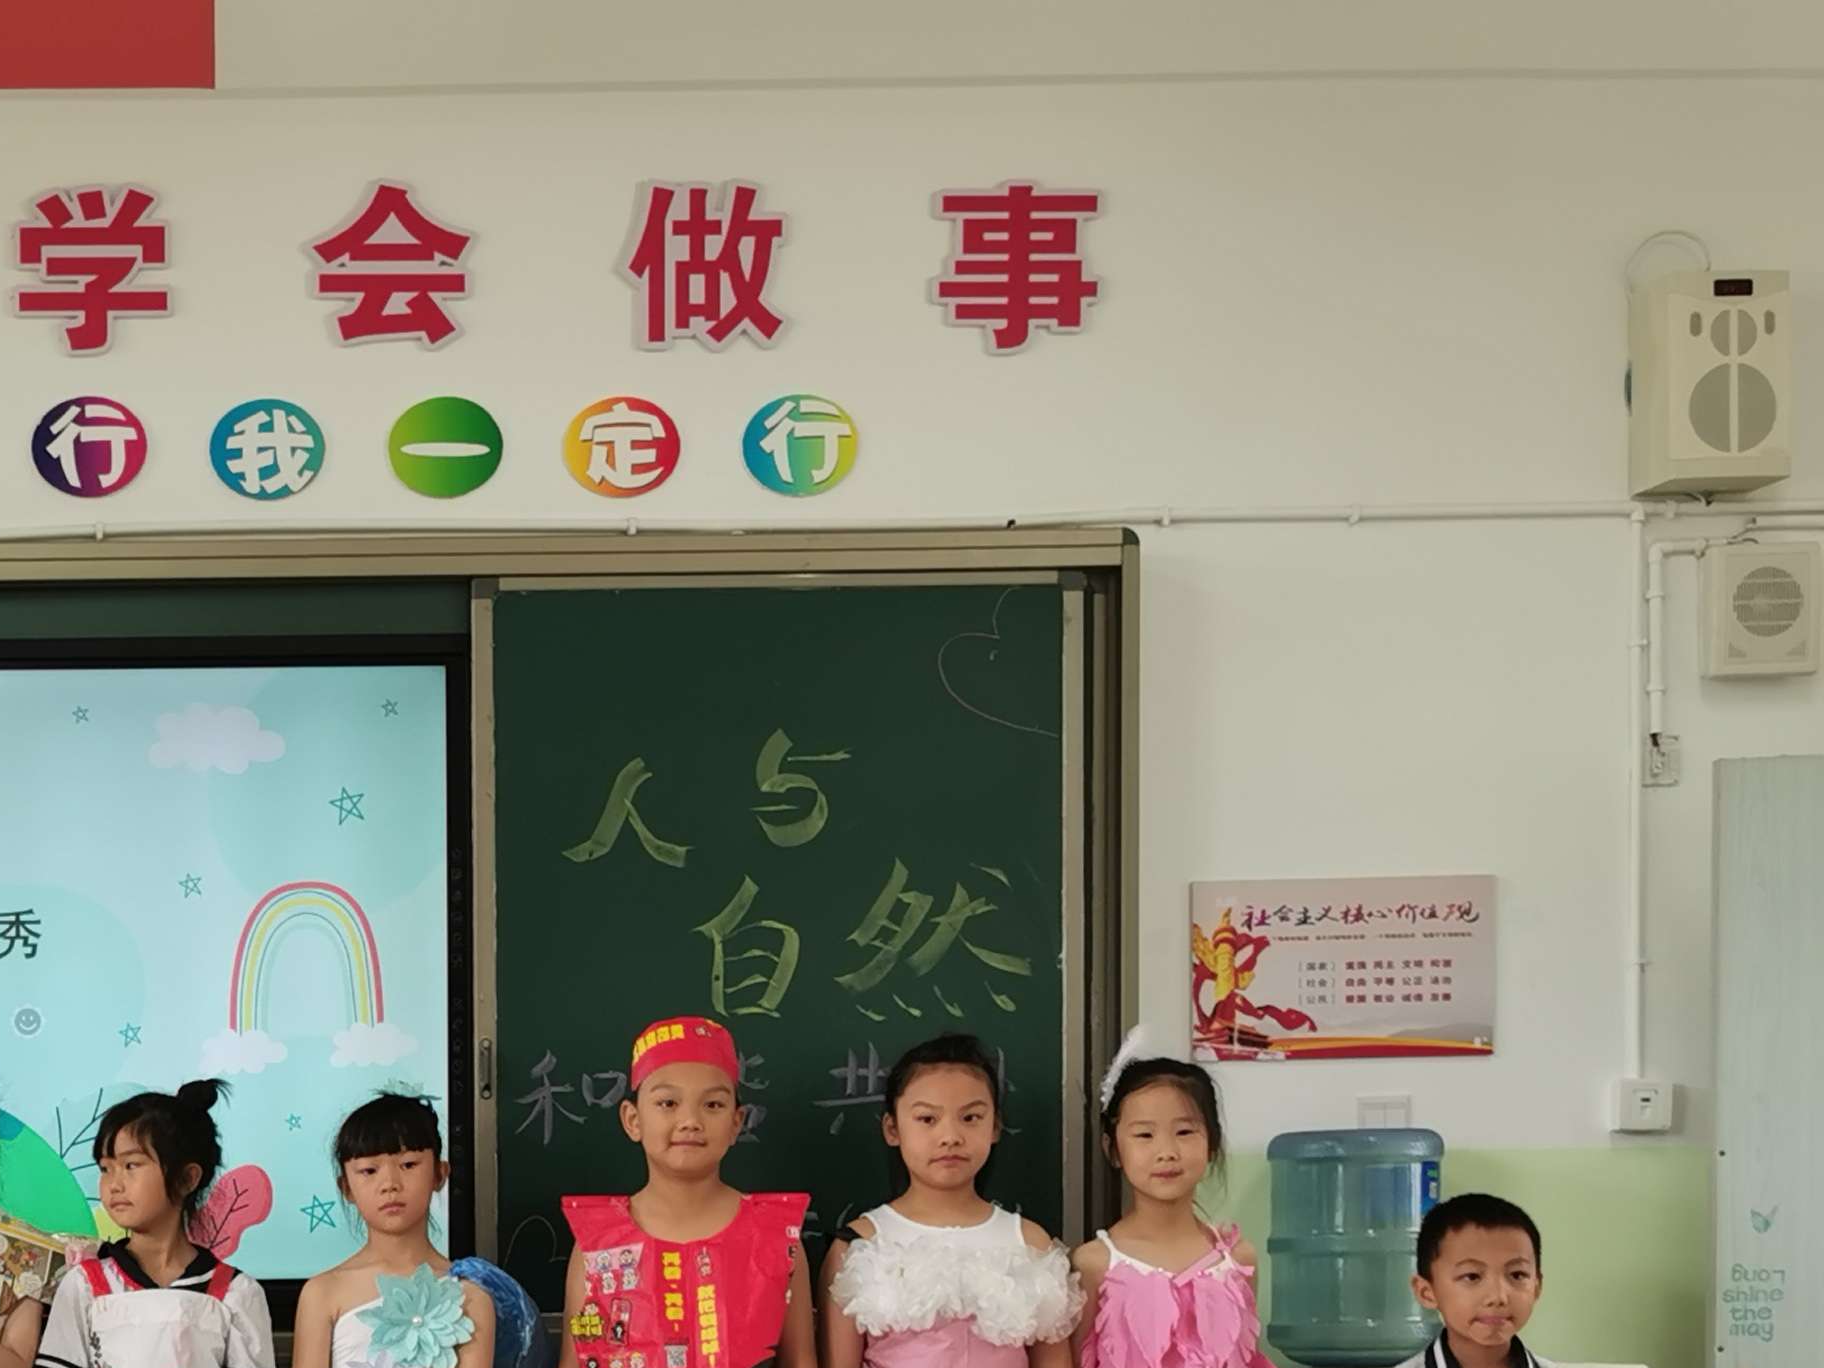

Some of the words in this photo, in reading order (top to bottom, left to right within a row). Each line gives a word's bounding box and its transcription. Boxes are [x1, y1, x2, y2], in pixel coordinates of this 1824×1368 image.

[19, 185, 1099, 350] 学会做事
[561, 729, 852, 868] 人与
[693, 857, 1032, 1021] 自然
[1729, 1305, 1773, 1321] the
